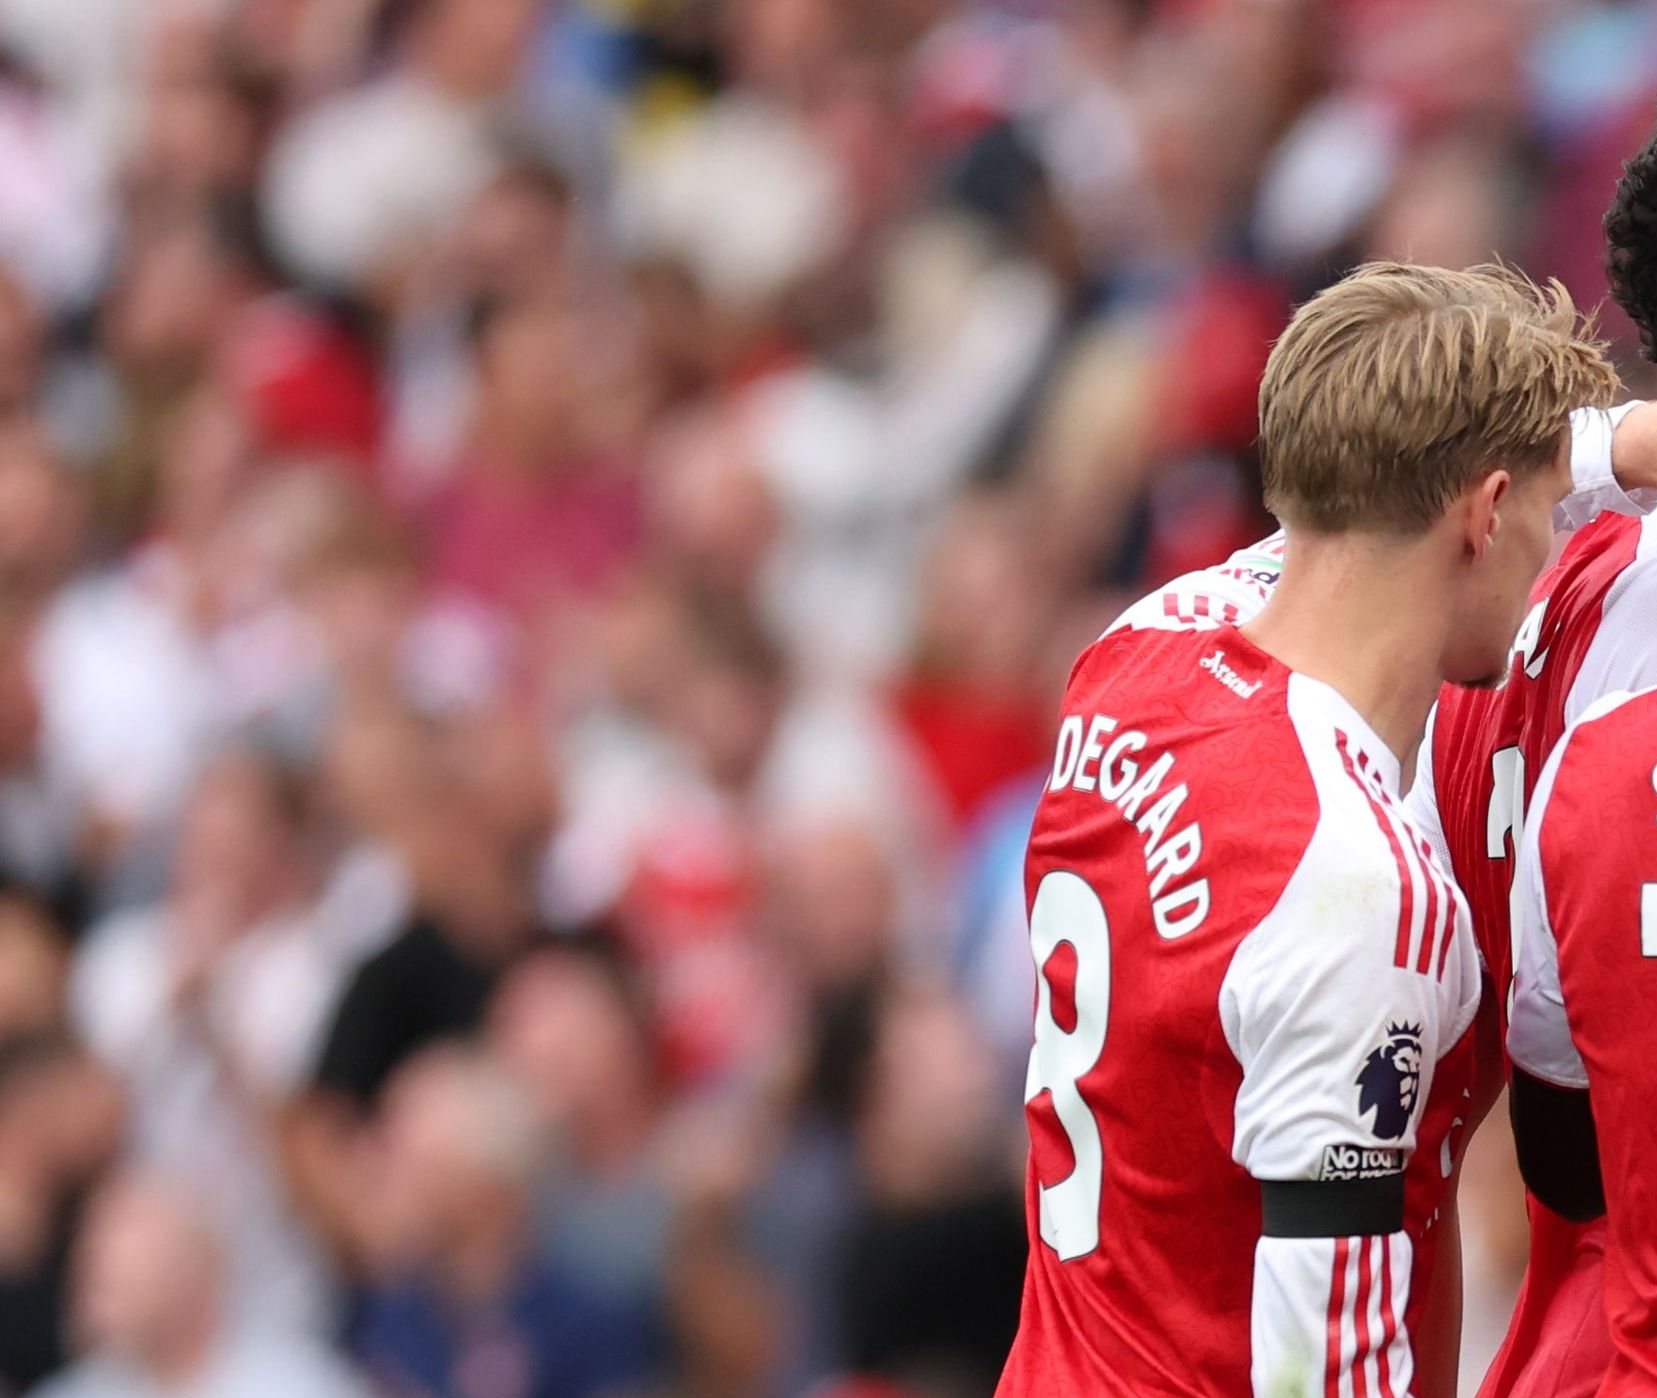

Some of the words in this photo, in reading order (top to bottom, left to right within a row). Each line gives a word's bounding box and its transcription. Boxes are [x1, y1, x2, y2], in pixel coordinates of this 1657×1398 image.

[1048, 714, 1211, 941] DEGAARD
[1024, 869, 1112, 1264] 8
[1323, 1145, 1359, 1170] No
